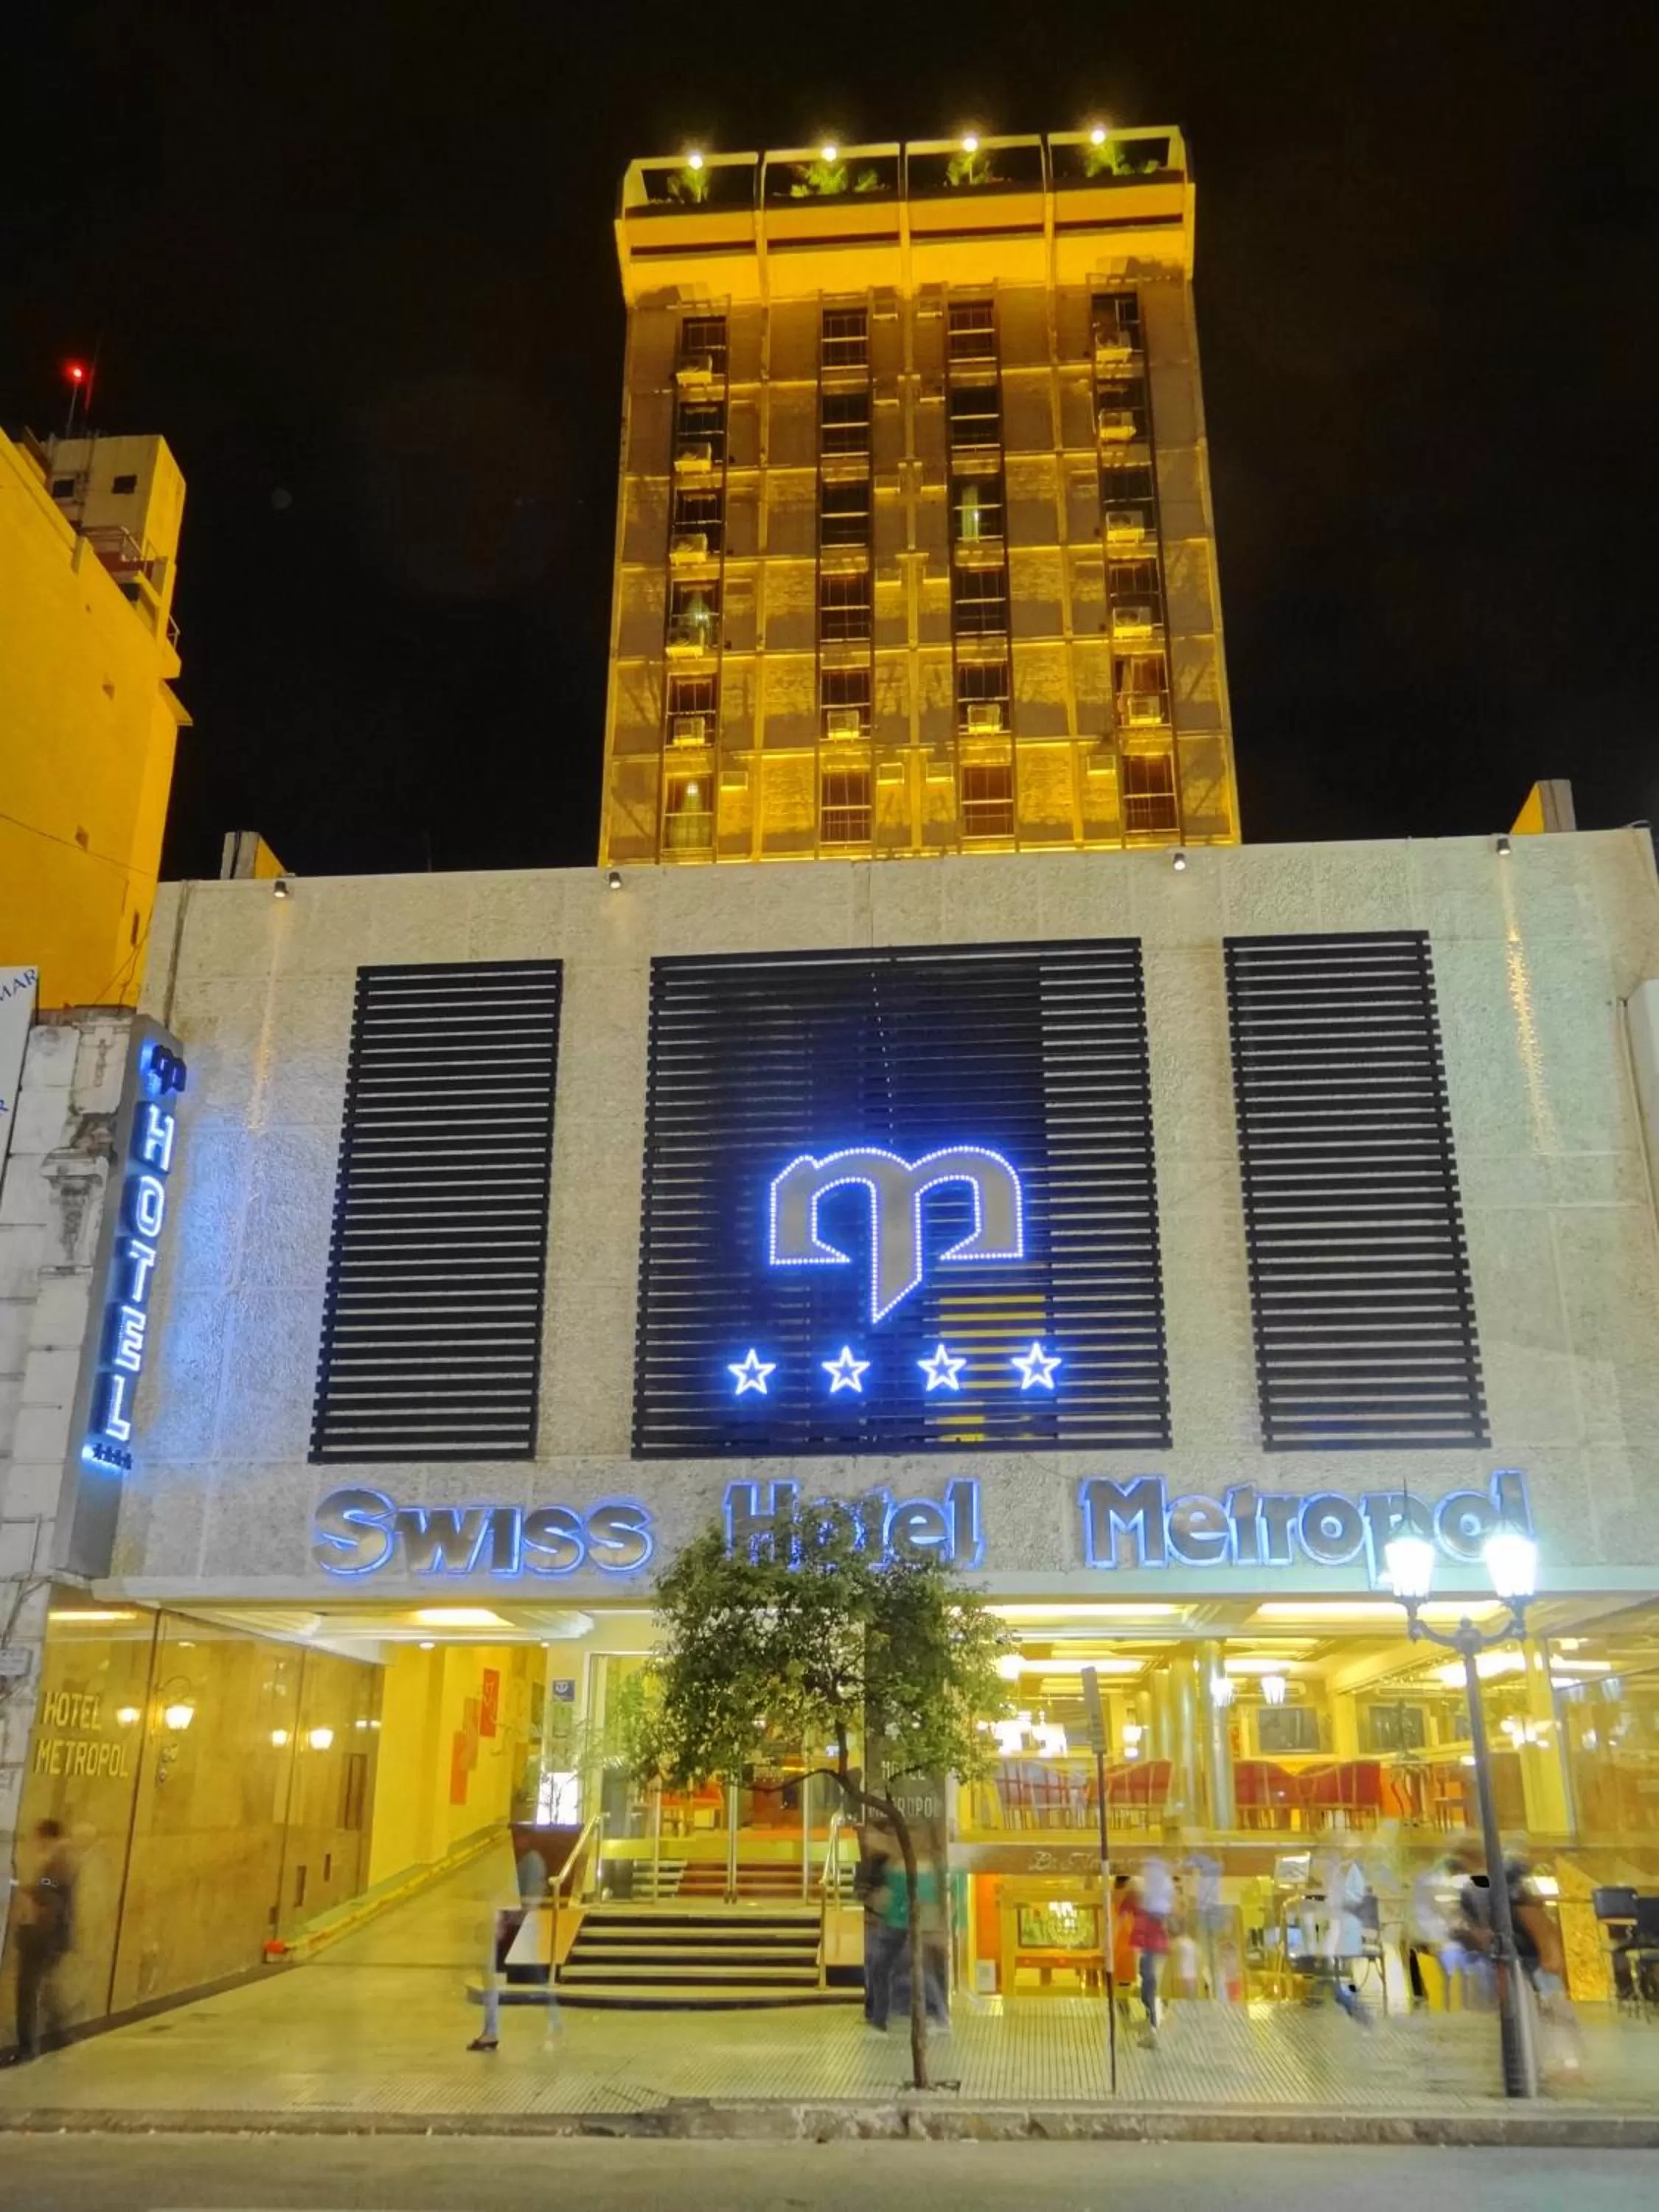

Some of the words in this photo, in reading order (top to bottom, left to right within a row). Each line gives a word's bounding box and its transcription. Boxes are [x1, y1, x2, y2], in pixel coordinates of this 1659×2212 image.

[91, 1101, 175, 1442] HOTEL
[311, 1484, 655, 1577] Swiss
[721, 1476, 985, 1573] Hotel
[1079, 1467, 1534, 1591] Metropol
[41, 1690, 102, 1731] HOTEL
[34, 1739, 128, 1778] METROPOL
